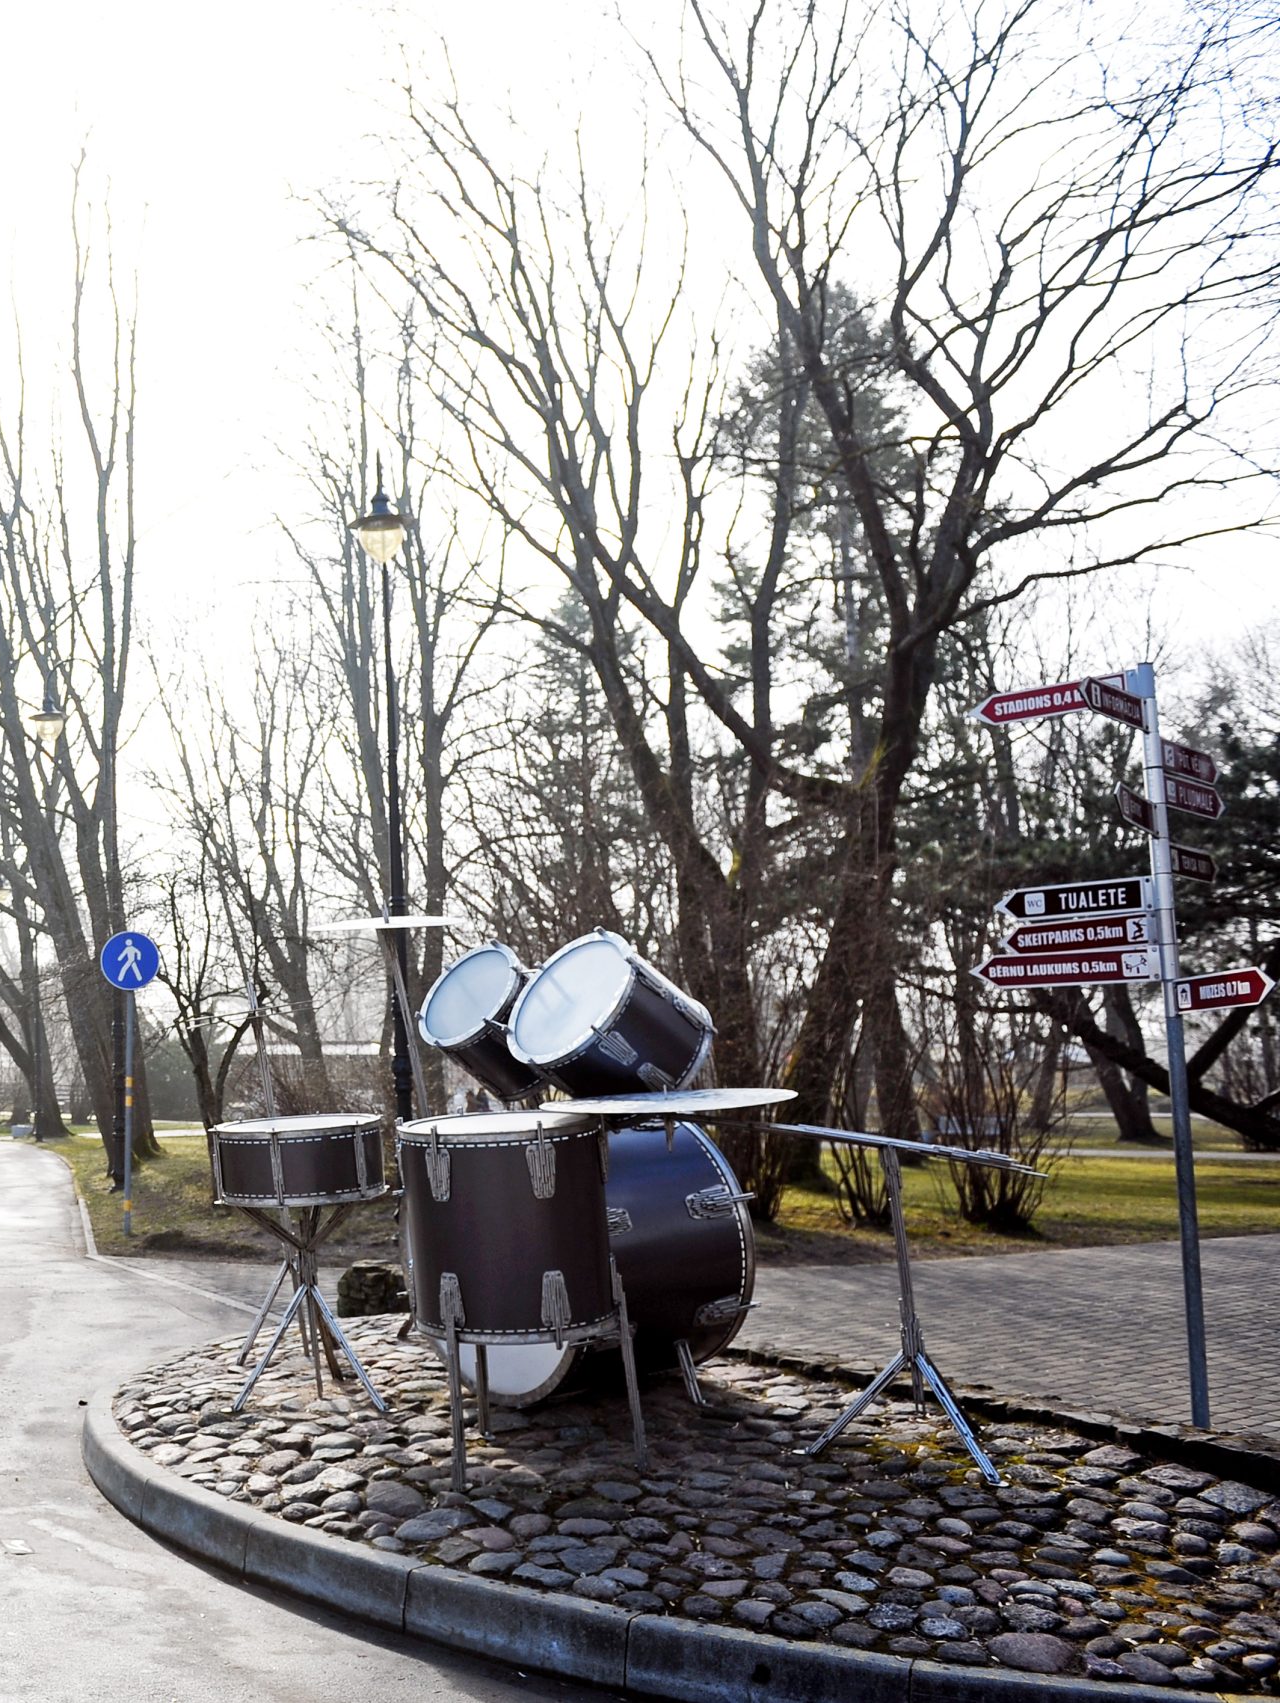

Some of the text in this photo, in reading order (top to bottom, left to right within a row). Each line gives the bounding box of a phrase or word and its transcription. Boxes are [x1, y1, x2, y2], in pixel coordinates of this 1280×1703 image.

[994, 694, 1051, 716] STADIONS
[1053, 690, 1072, 706] 0,4
[1026, 898, 1042, 909] WC
[1058, 887, 1127, 910] TUALETE
[1017, 928, 1084, 948] SKEITPARKS
[988, 964, 1025, 979] BĒRNU
[1026, 962, 1079, 976] LAUKUMS
